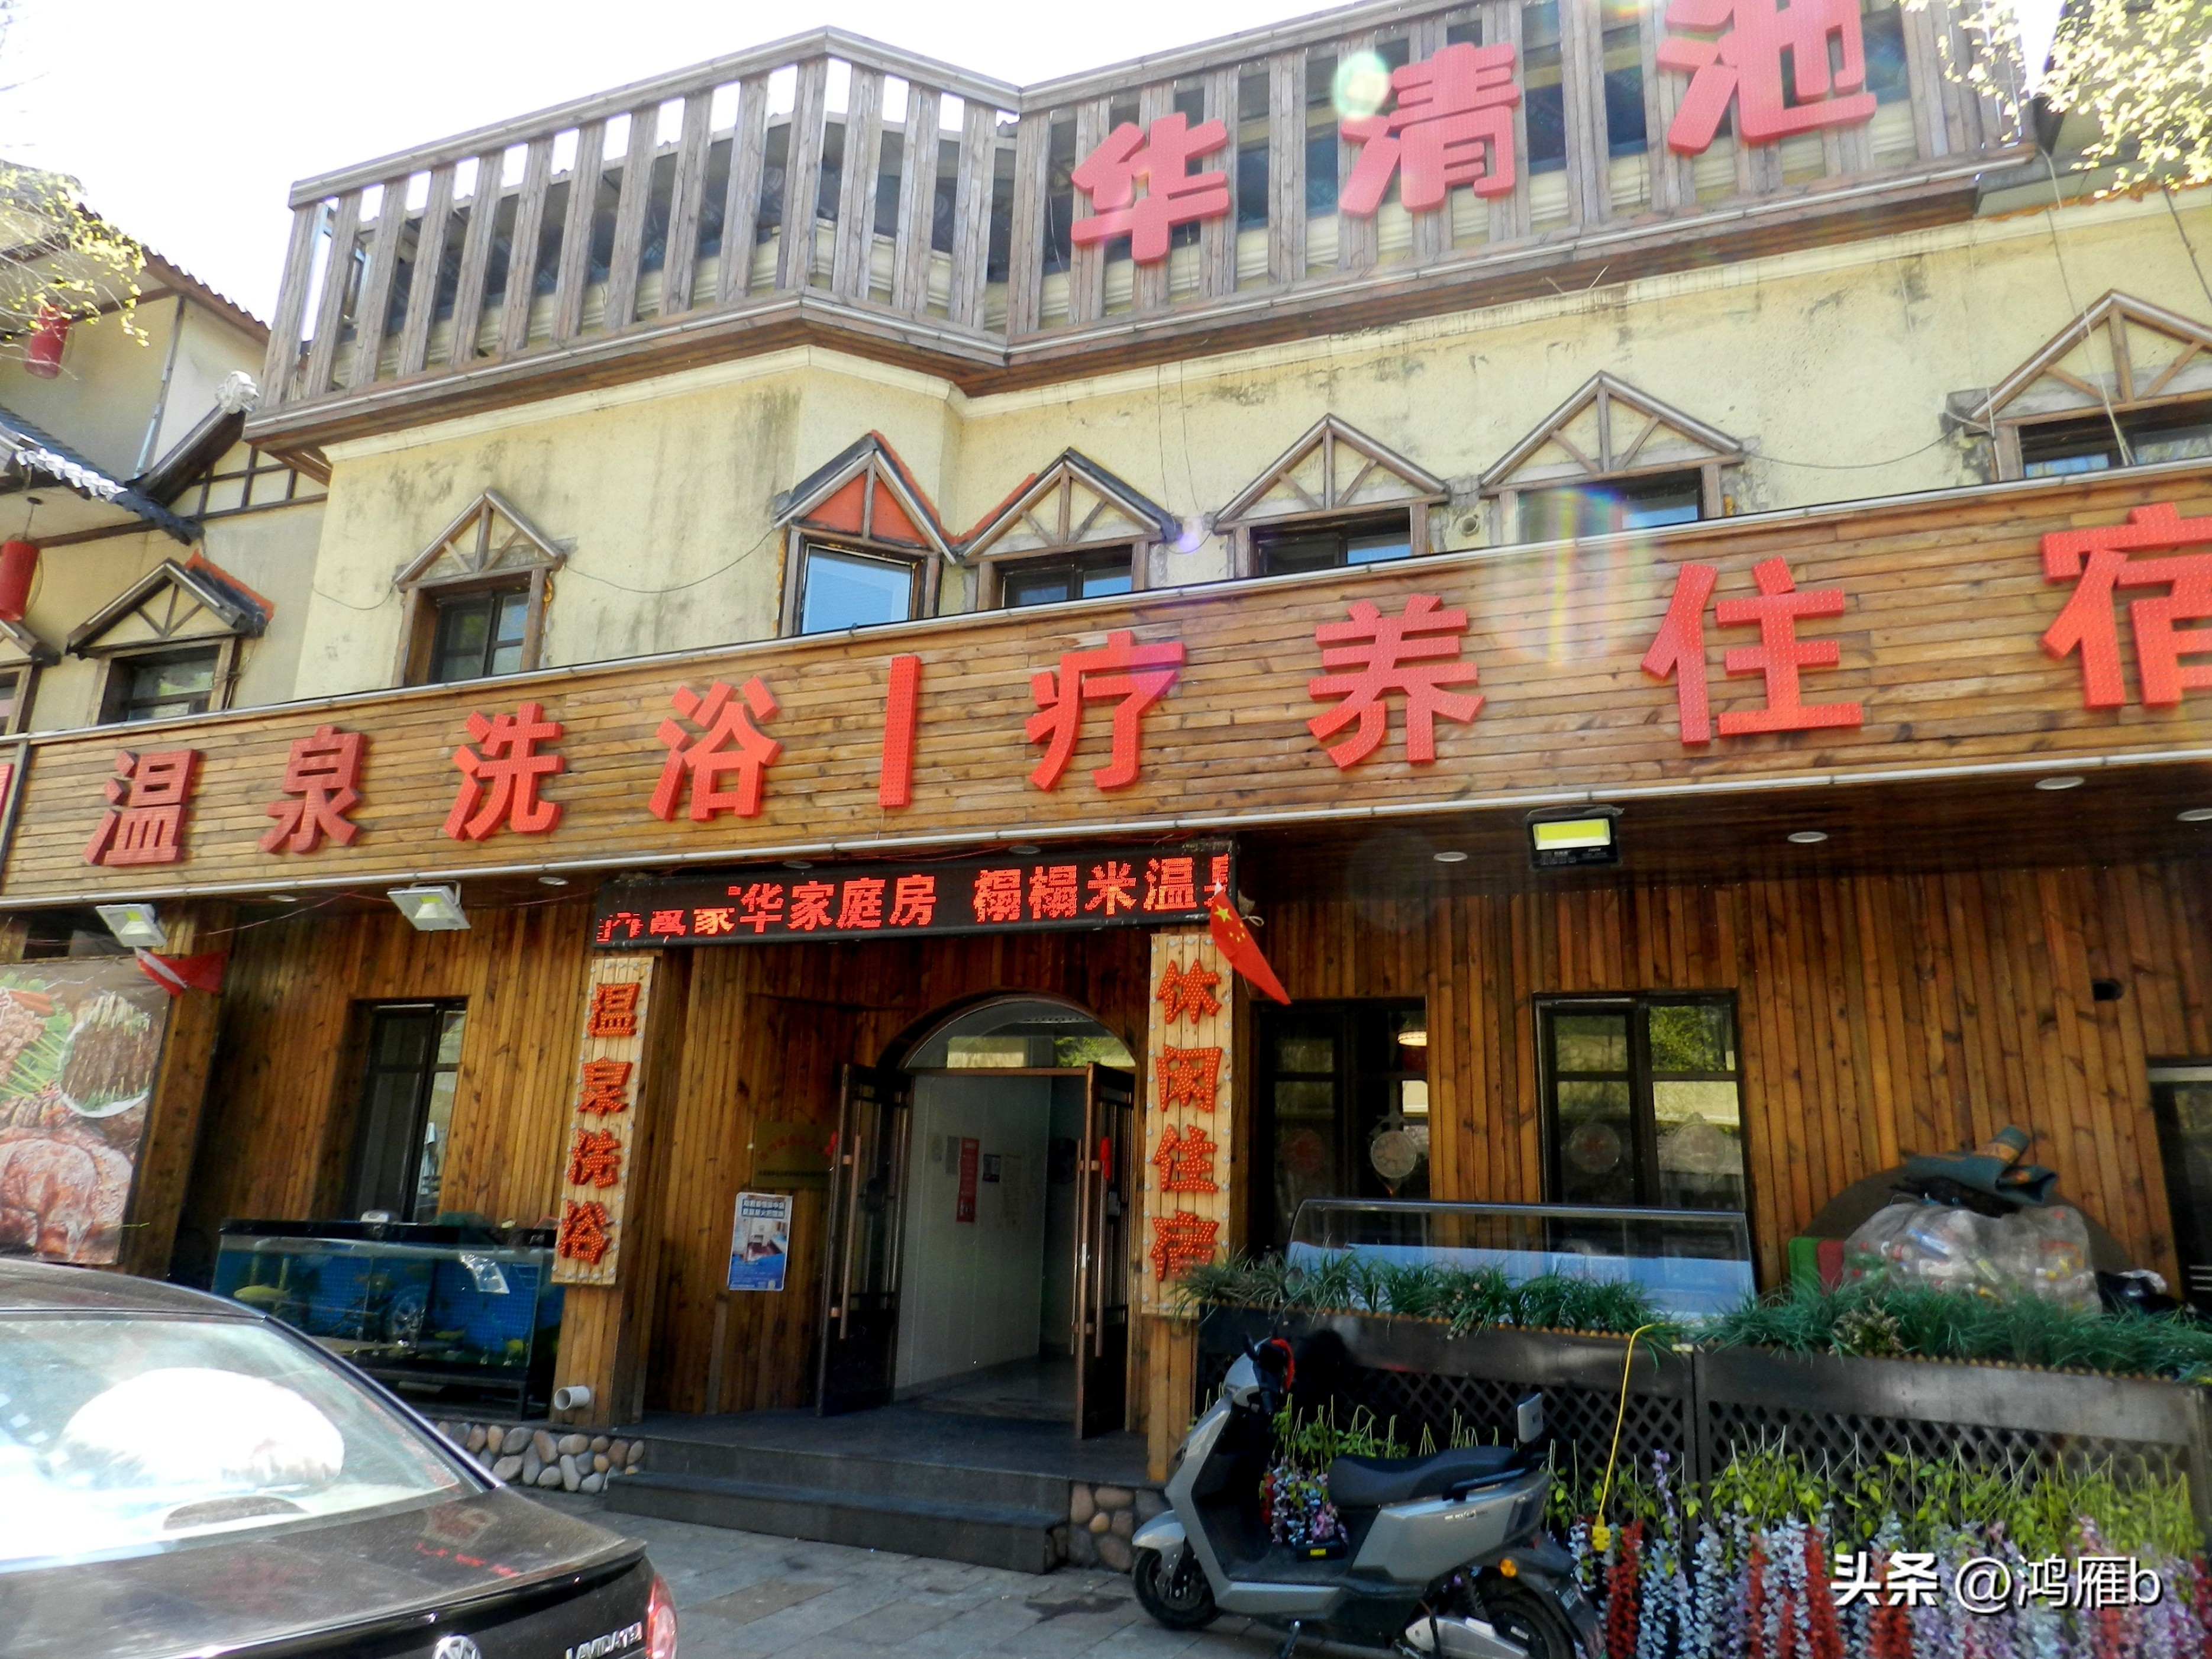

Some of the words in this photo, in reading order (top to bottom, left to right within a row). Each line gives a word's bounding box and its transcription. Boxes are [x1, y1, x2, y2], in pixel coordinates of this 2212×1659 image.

[1071, 0, 1877, 264] 华清池
[557, 982, 641, 1265] 温泉洗浴
[1149, 958, 1222, 1282] 休闲住宿
